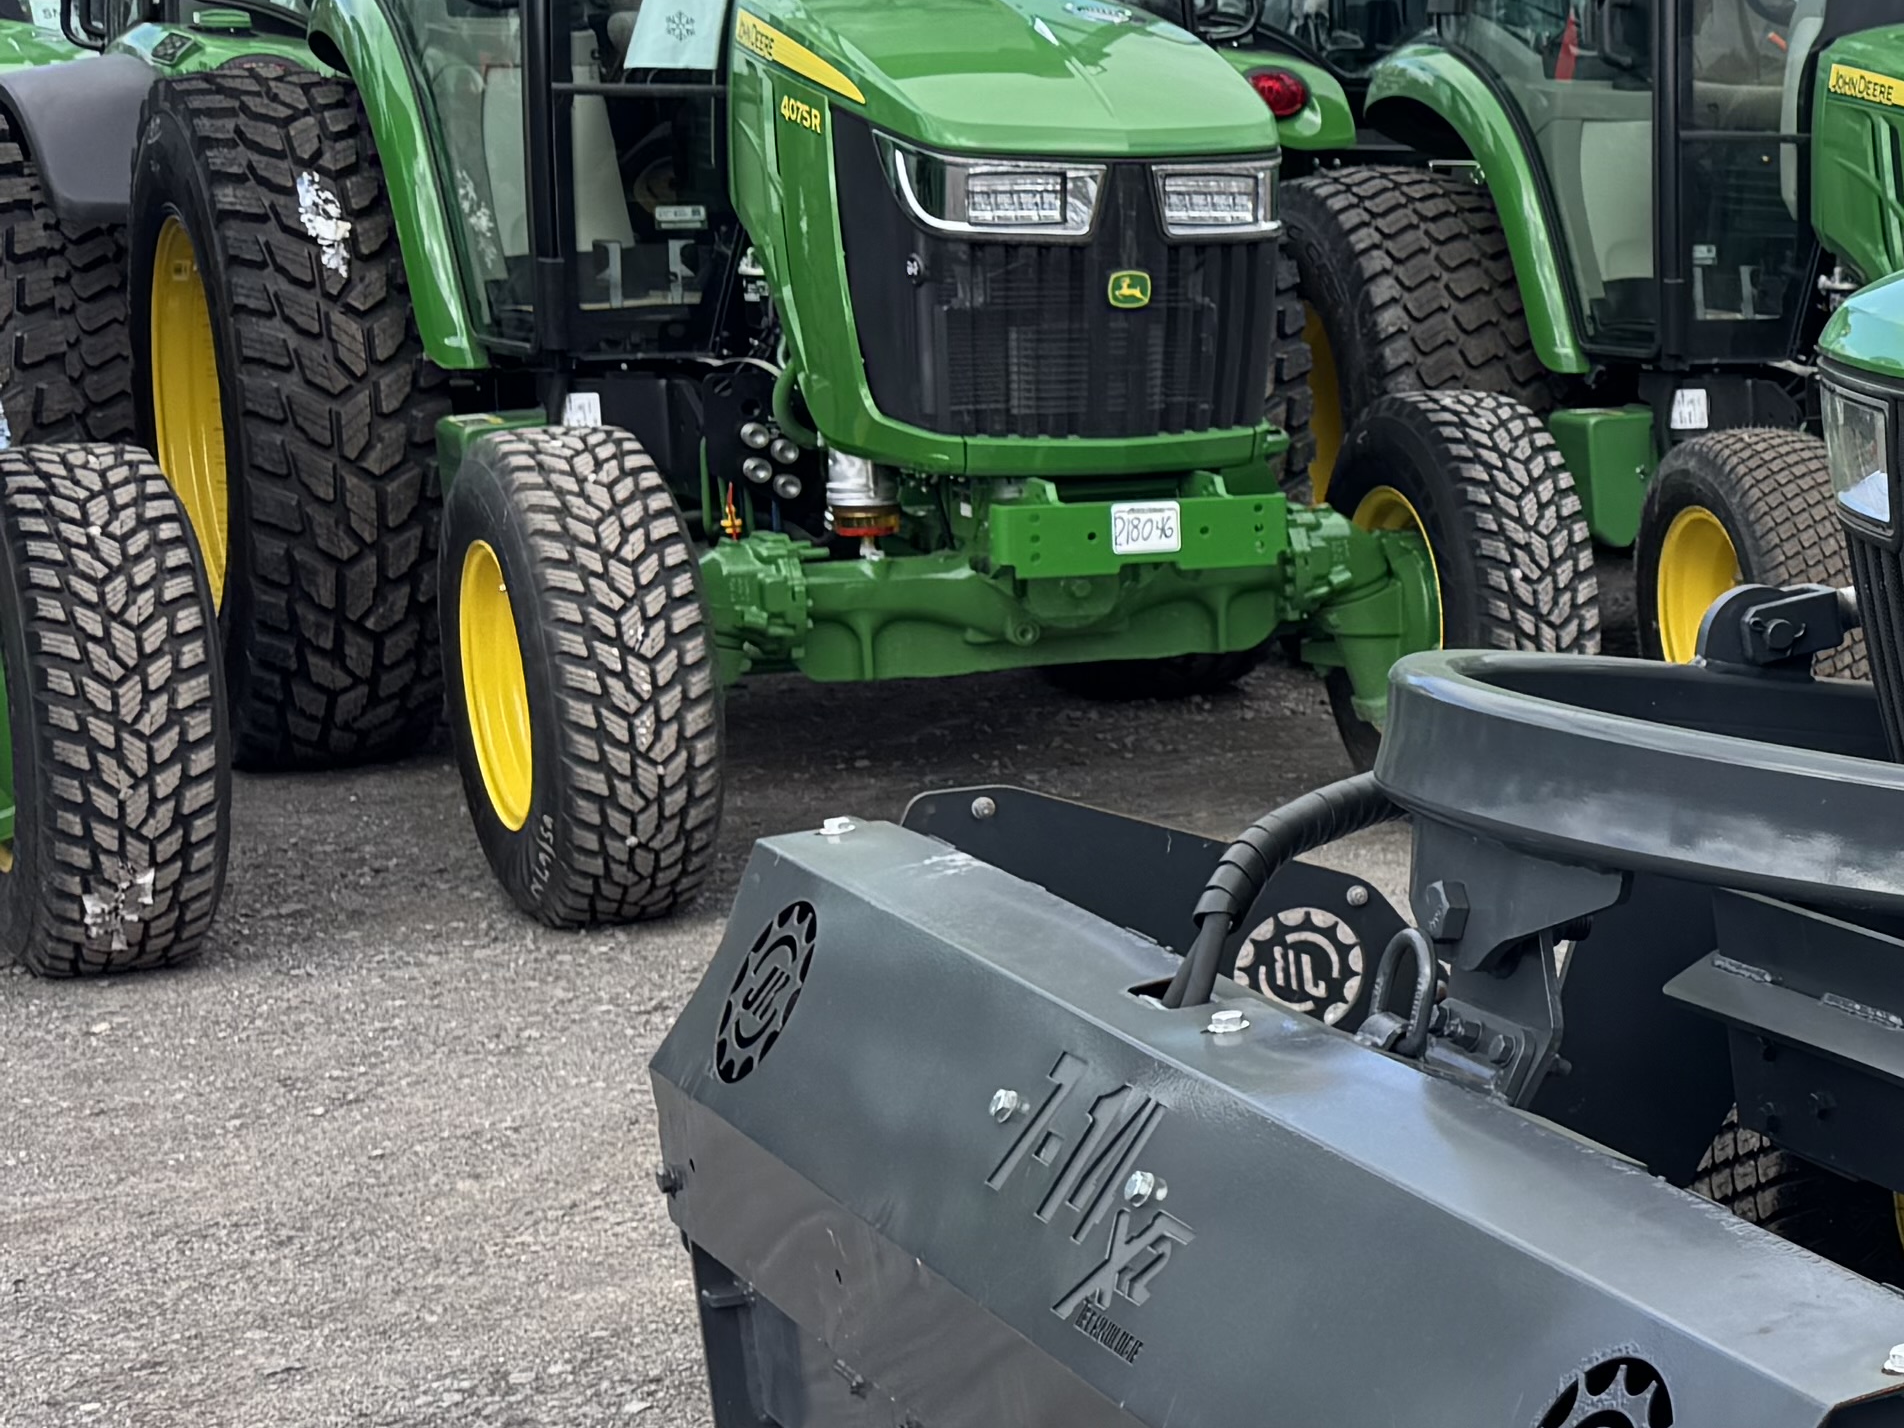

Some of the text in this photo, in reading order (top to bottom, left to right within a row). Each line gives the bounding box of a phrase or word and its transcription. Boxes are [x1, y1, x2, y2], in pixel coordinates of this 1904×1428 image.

[751, 24, 775, 56] DEERE
[1832, 70, 1894, 101] JOHN DEERE
